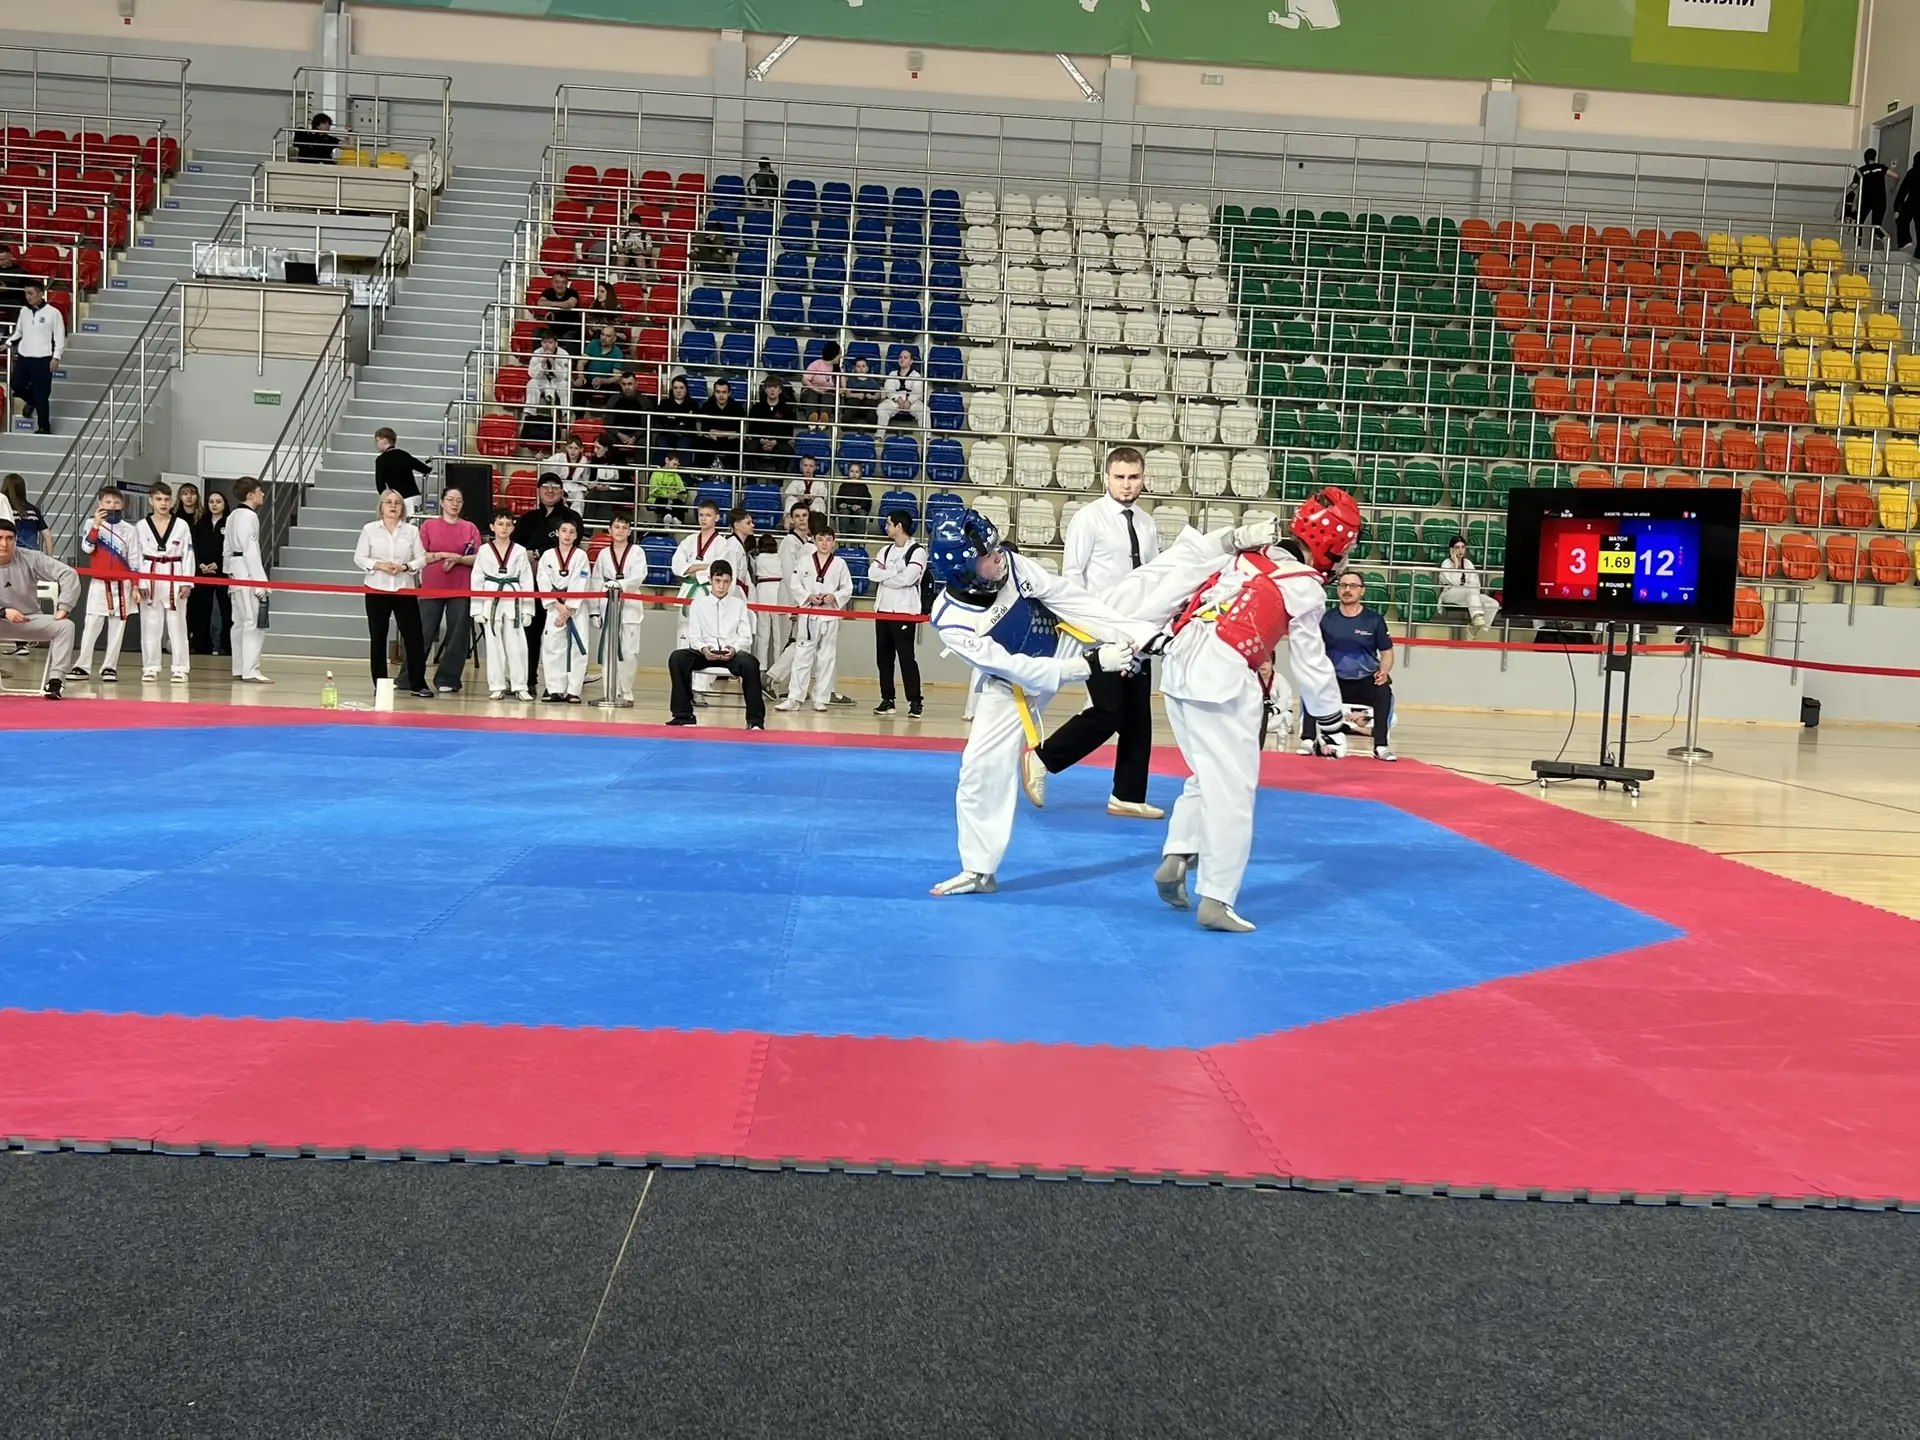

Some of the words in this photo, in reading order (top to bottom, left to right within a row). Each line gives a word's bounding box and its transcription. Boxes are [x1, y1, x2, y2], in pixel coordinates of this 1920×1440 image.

[1569, 547, 1587, 574] 3
[1603, 556, 1631, 568] 1.69
[1639, 549, 1675, 576] 12
[1611, 588, 1617, 596] 3
